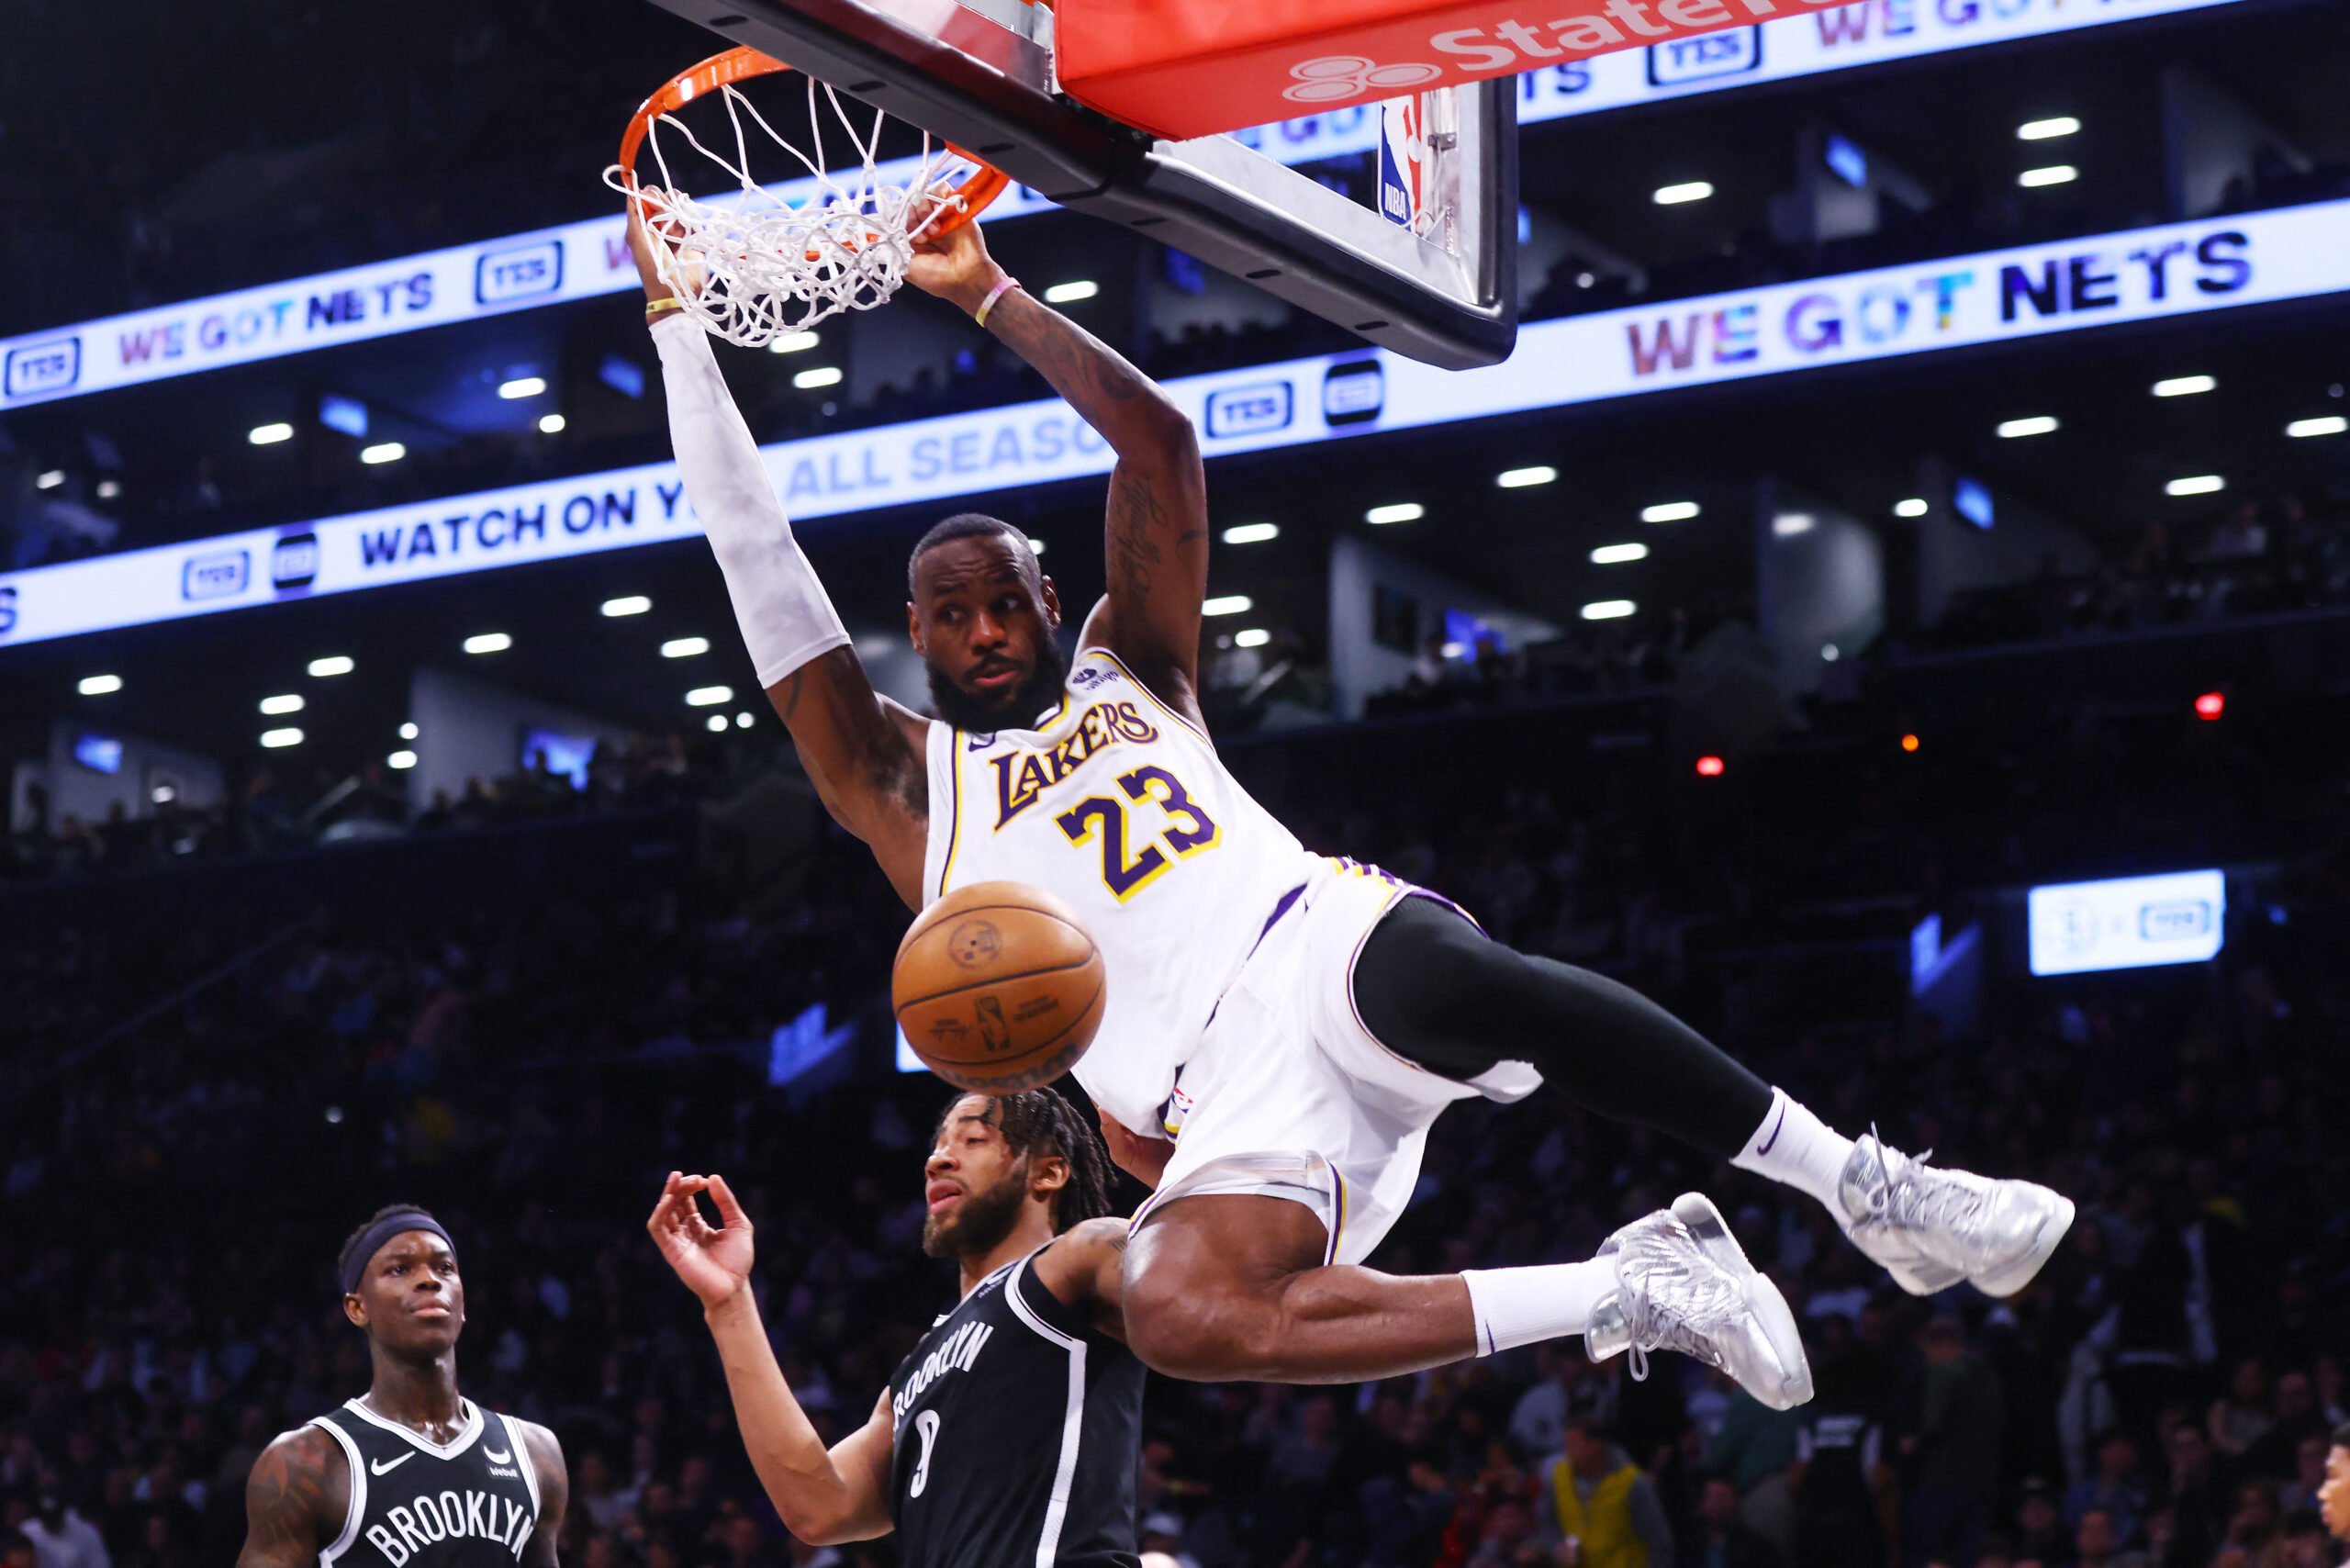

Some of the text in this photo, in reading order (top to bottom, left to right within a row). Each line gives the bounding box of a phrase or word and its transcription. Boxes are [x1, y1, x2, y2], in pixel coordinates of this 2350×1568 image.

[1384, 182, 1406, 221] NBA
[119, 322, 184, 365] WE
[199, 299, 293, 351] GOT
[307, 273, 434, 330] NETS
[361, 504, 545, 567] WATCH
[562, 488, 636, 533] ON
[786, 446, 891, 498] ALL
[911, 416, 1107, 481] SEASO
[1627, 304, 1759, 375] WE
[1785, 270, 1975, 353] GOT
[2000, 230, 2253, 322] NETS
[988, 700, 1160, 835] LAKERS
[1052, 764, 1223, 906] 23
[892, 1320, 995, 1434] ROOKLYN
[365, 1489, 534, 1568] BROOKLYN
